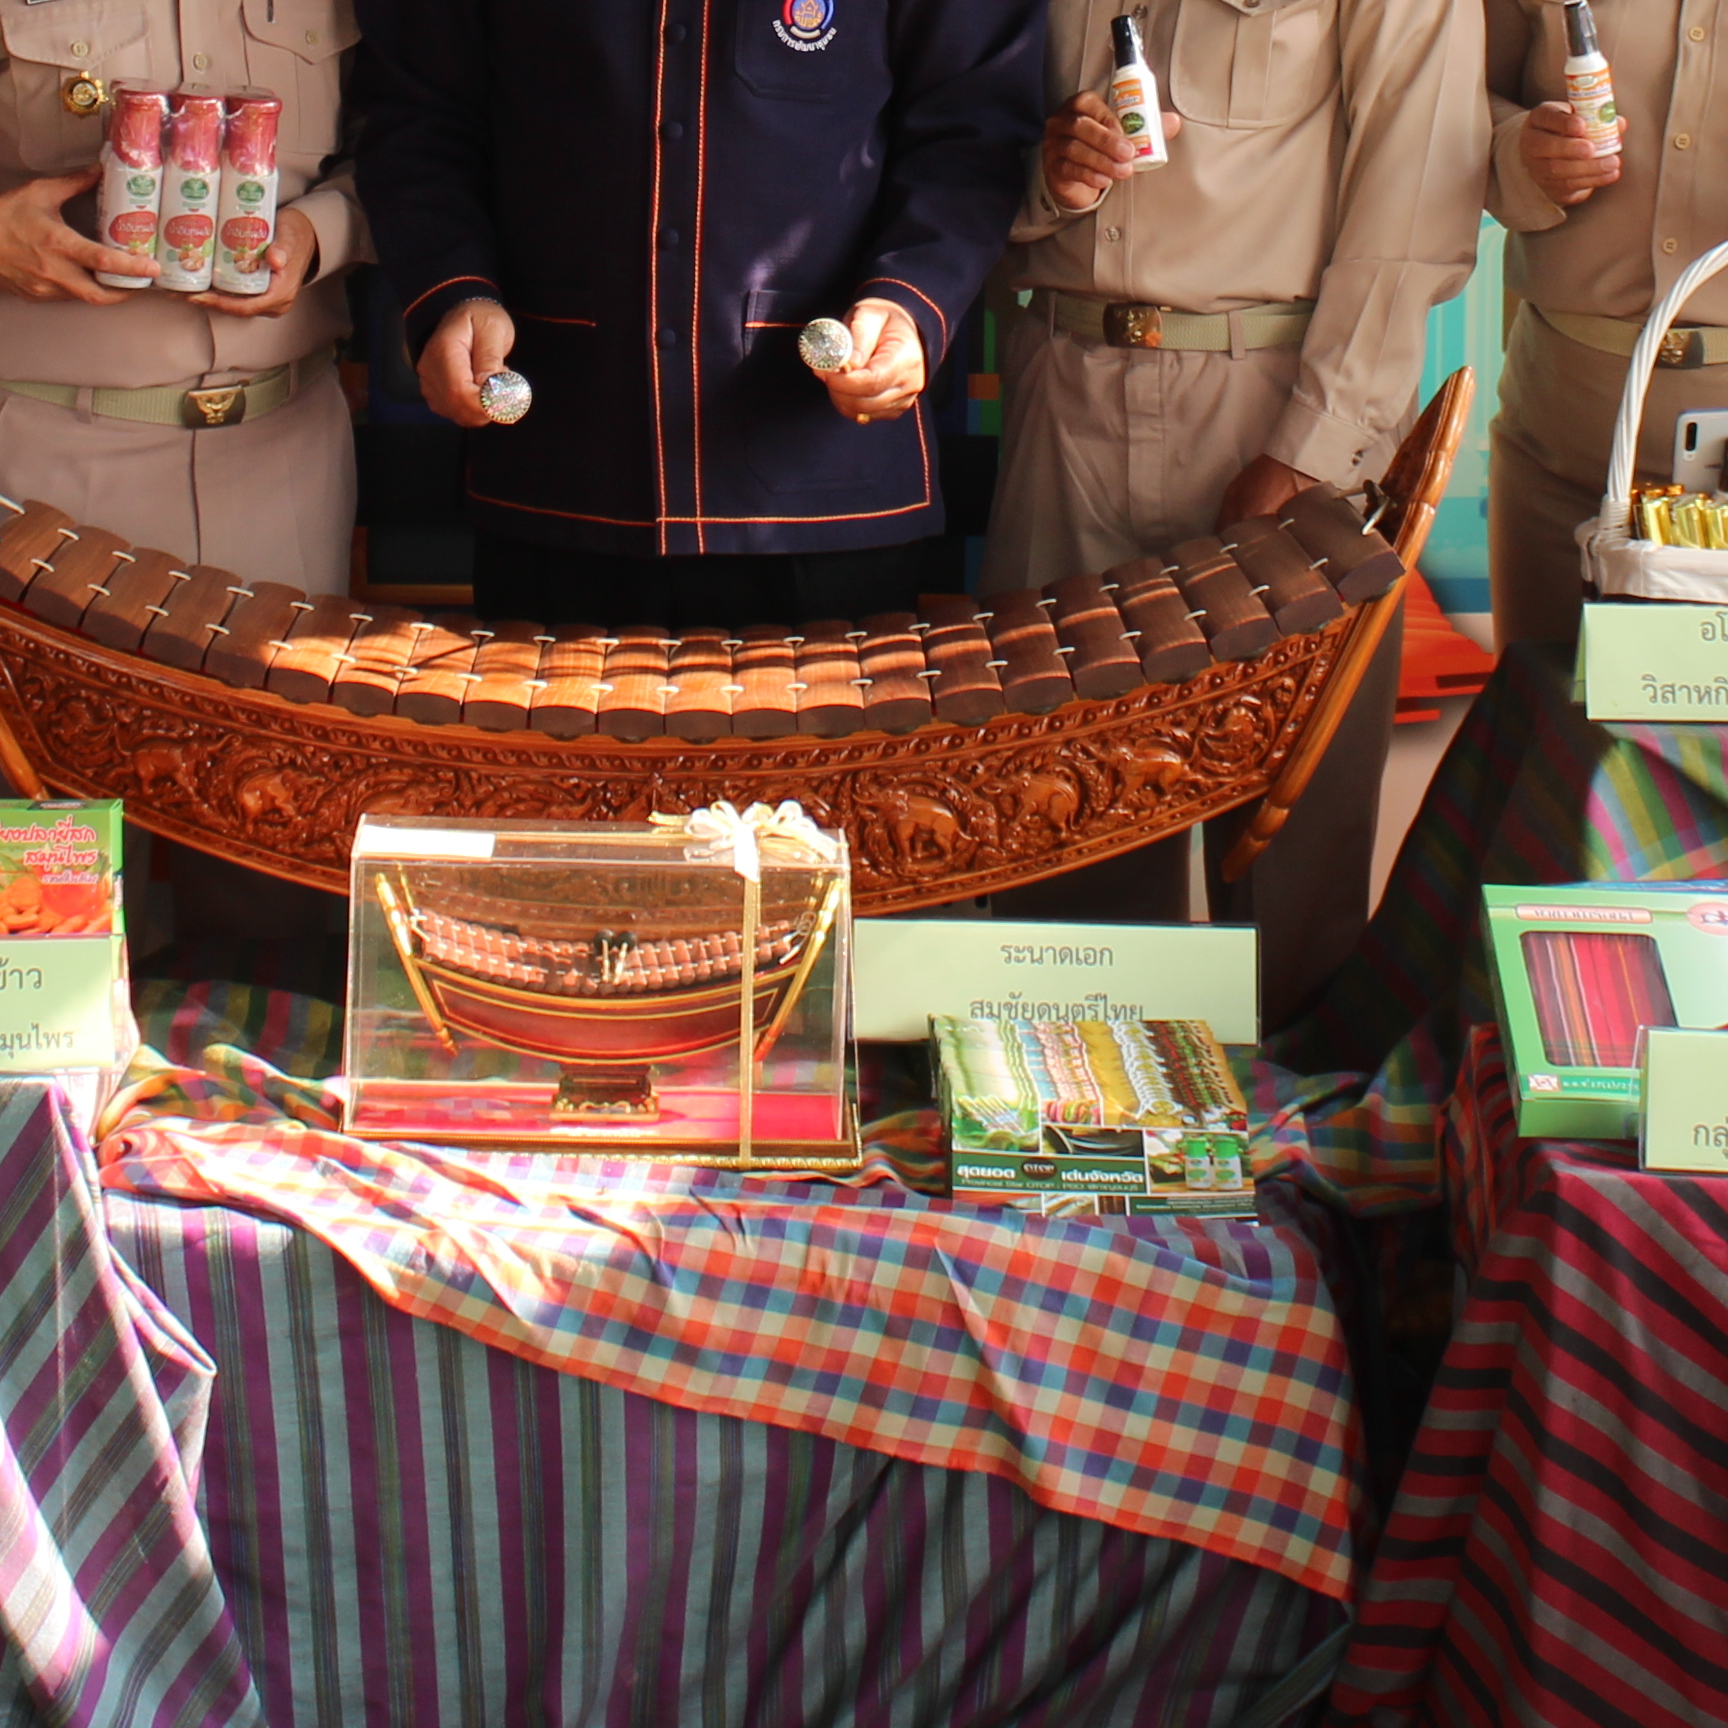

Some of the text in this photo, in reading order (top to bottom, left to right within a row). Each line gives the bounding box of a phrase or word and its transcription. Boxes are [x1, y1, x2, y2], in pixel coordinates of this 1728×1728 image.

[24, 841, 98, 872] สมุนไพร
[999, 943, 1115, 967] ระนาดเอก
[969, 992, 1144, 1022] สมชัยดนตรีไทย
[956, 1164, 1016, 1180] สุดยอด
